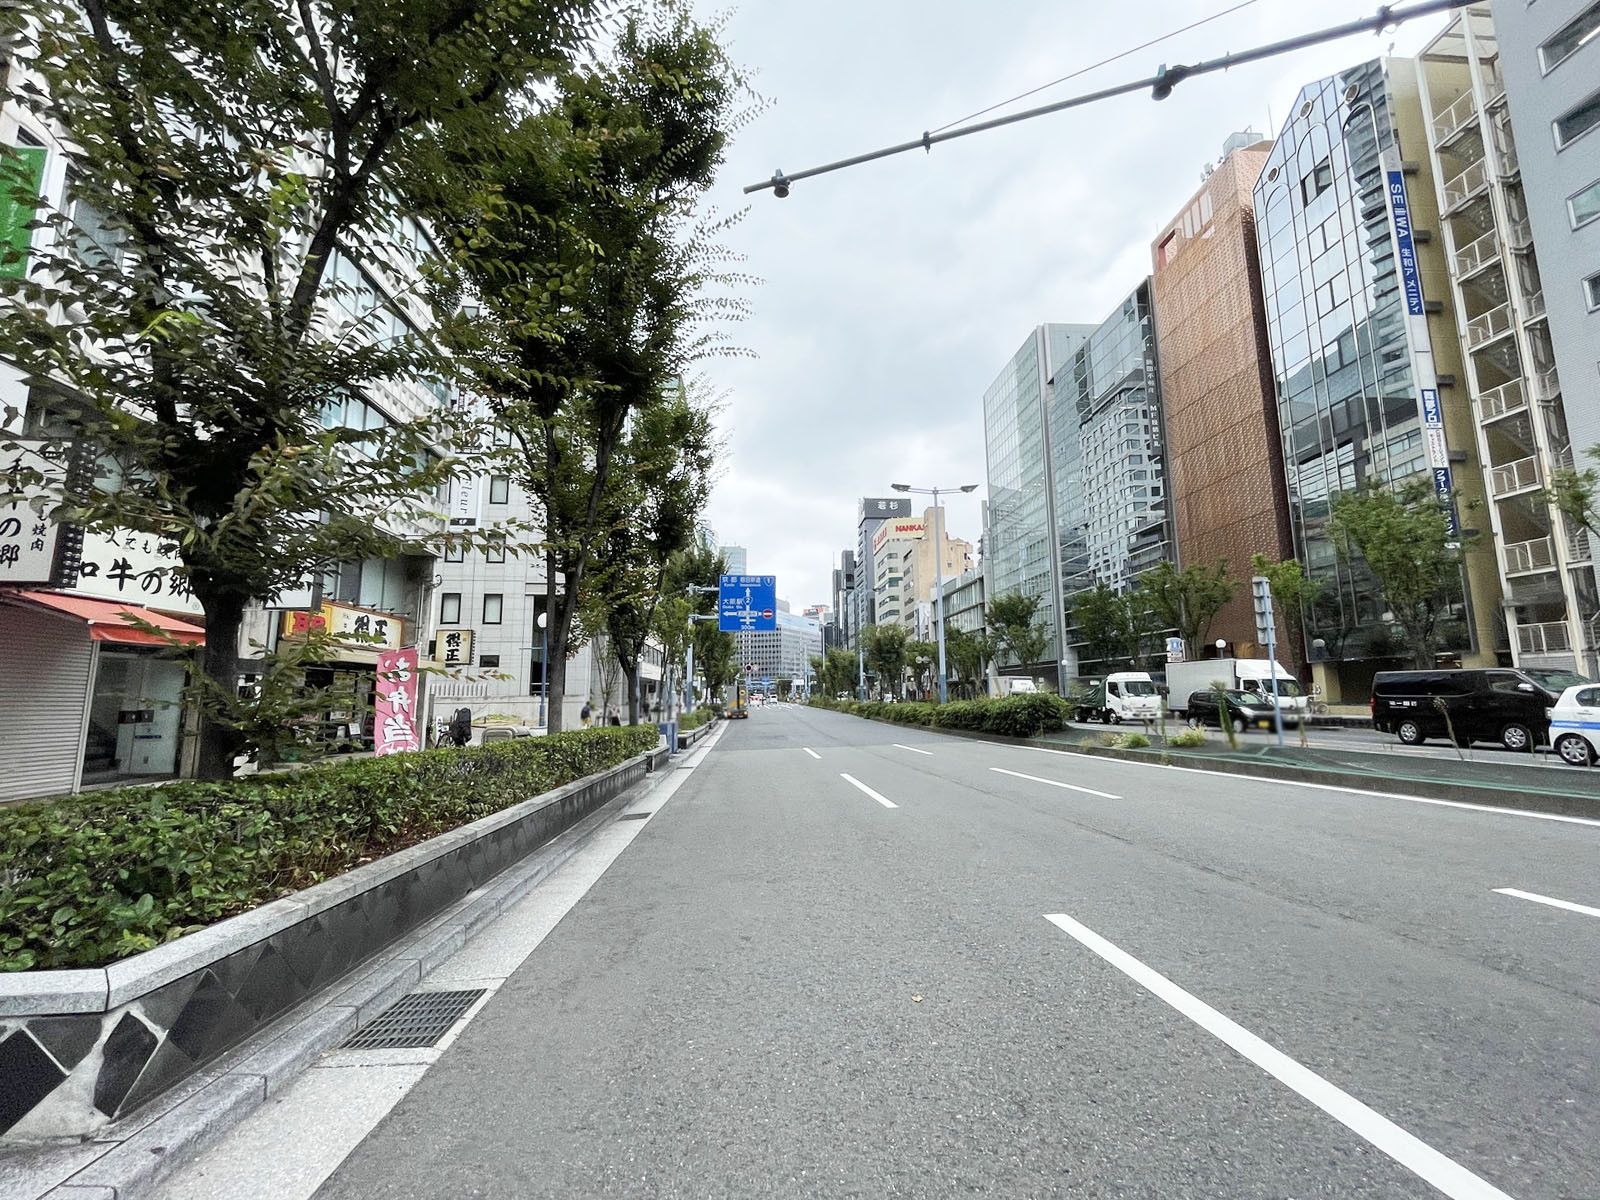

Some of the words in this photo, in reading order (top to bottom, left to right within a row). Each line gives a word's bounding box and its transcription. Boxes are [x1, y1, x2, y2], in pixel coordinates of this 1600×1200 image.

[1401, 248, 1420, 313] 生和アメニティ
